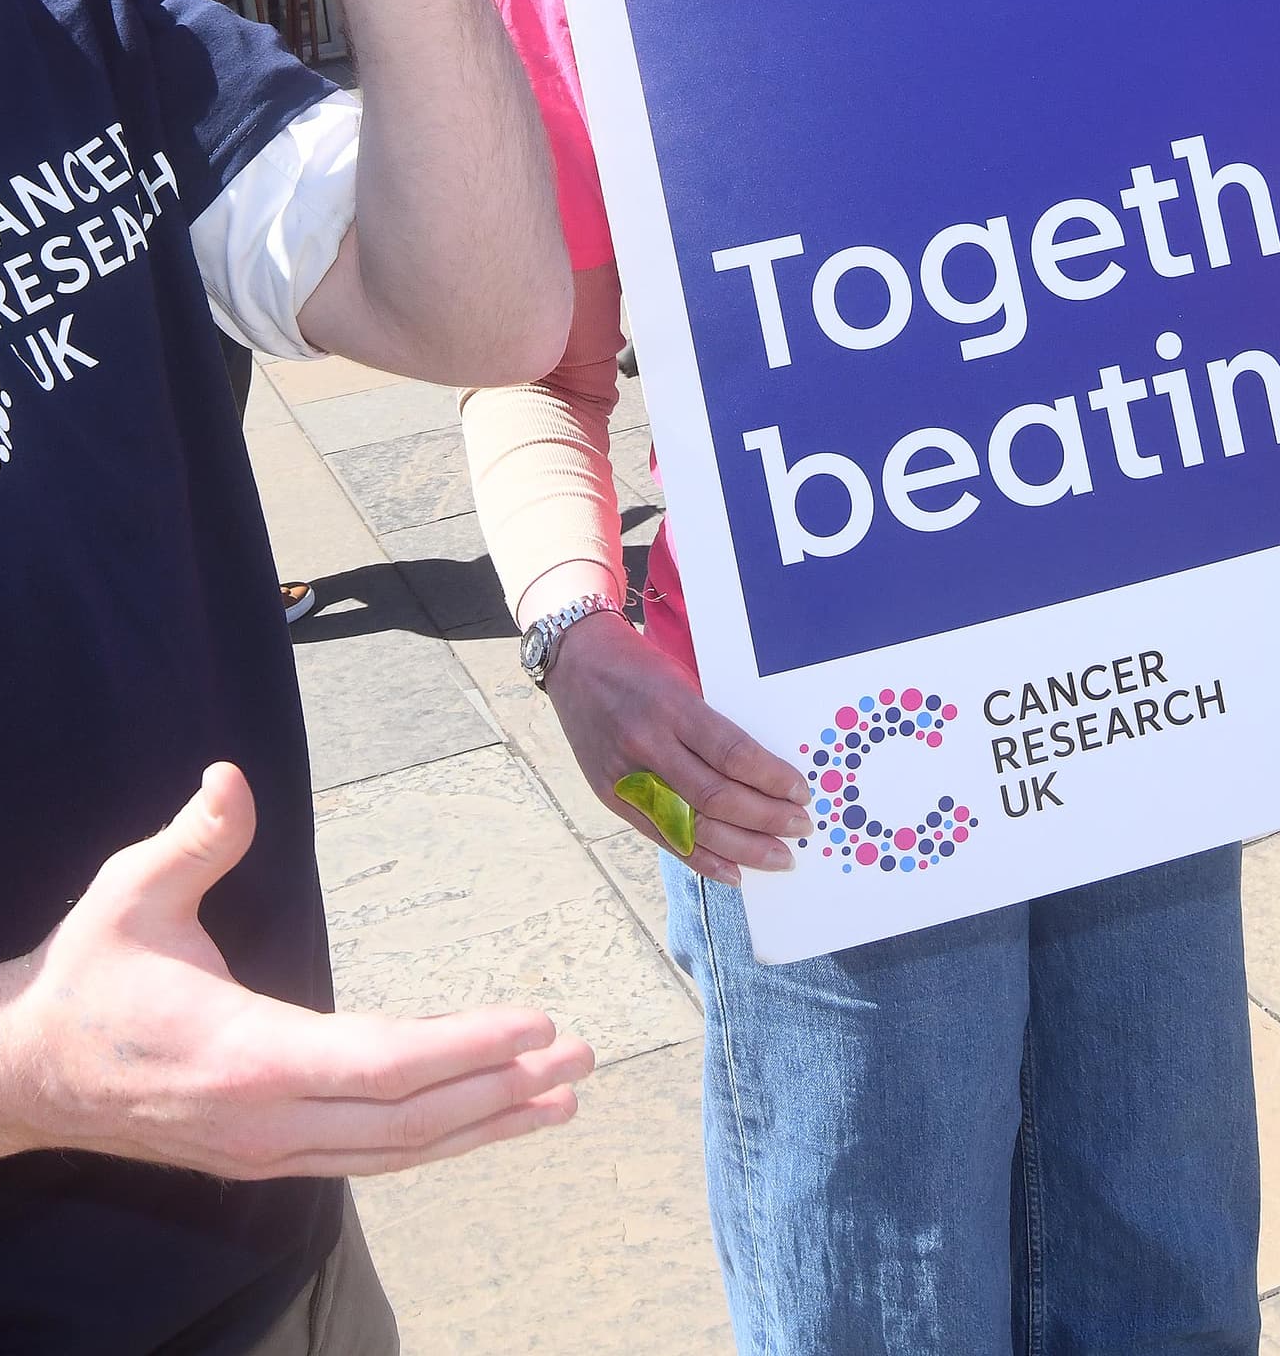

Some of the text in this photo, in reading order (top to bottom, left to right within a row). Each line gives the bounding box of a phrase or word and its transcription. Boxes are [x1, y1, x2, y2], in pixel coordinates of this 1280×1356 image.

[9, 313, 100, 392] UK
[983, 650, 1169, 726] CANCER
[991, 679, 1226, 774] RESEARCH
[999, 771, 1065, 818] UK
